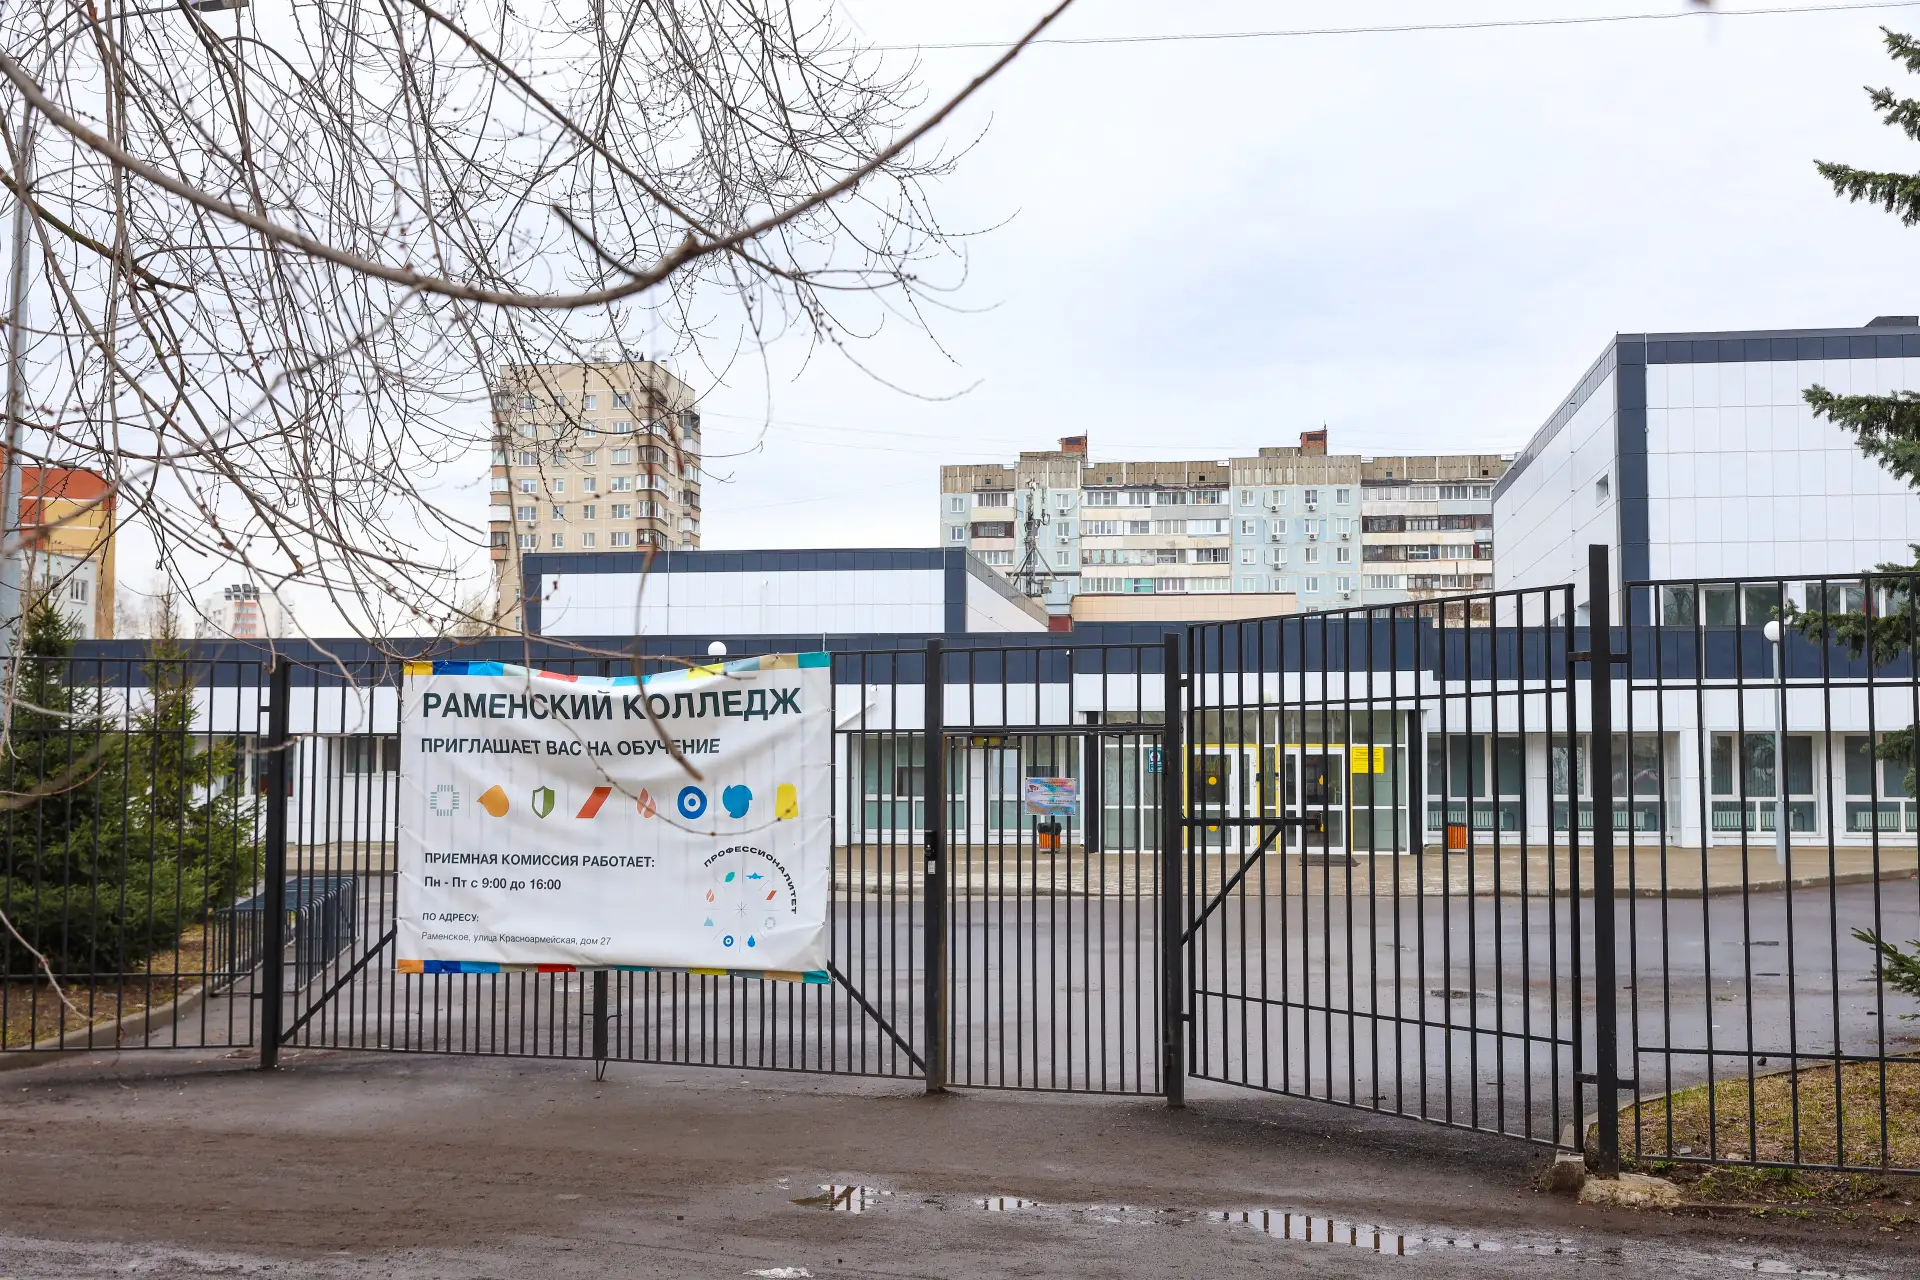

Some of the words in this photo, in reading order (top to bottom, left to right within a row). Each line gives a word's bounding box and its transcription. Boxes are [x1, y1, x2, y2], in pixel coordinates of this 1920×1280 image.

[423, 690, 613, 720] РАМЕНСКИЙ
[623, 687, 802, 721] КОЛЛЕДЖ
[421, 738, 541, 755] ПРИГЛАШАЕТ
[546, 741, 582, 756] ВАС
[587, 741, 613, 756] НА
[424, 852, 498, 865] ПРИЕМНАЯ
[501, 854, 579, 867] КОМИССИЯ
[582, 855, 655, 868] РАБОТАЕТ:
[424, 876, 441, 887] Пн
[452, 877, 468, 888] Пт
[470, 879, 479, 889] с
[482, 877, 507, 889] 9:00
[509, 880, 526, 891] до
[530, 878, 561, 890] 16:00
[703, 846, 797, 915] ПРОФЕССИОНАЛИТЕТ
[422, 912, 437, 921] ПО
[438, 913, 479, 923] АДРЕСУ:
[421, 931, 471, 942] Раменское,
[473, 933, 498, 944] улица
[499, 933, 578, 945] Красноармейская,
[580, 937, 598, 946] дом
[600, 936, 611, 946] 27
